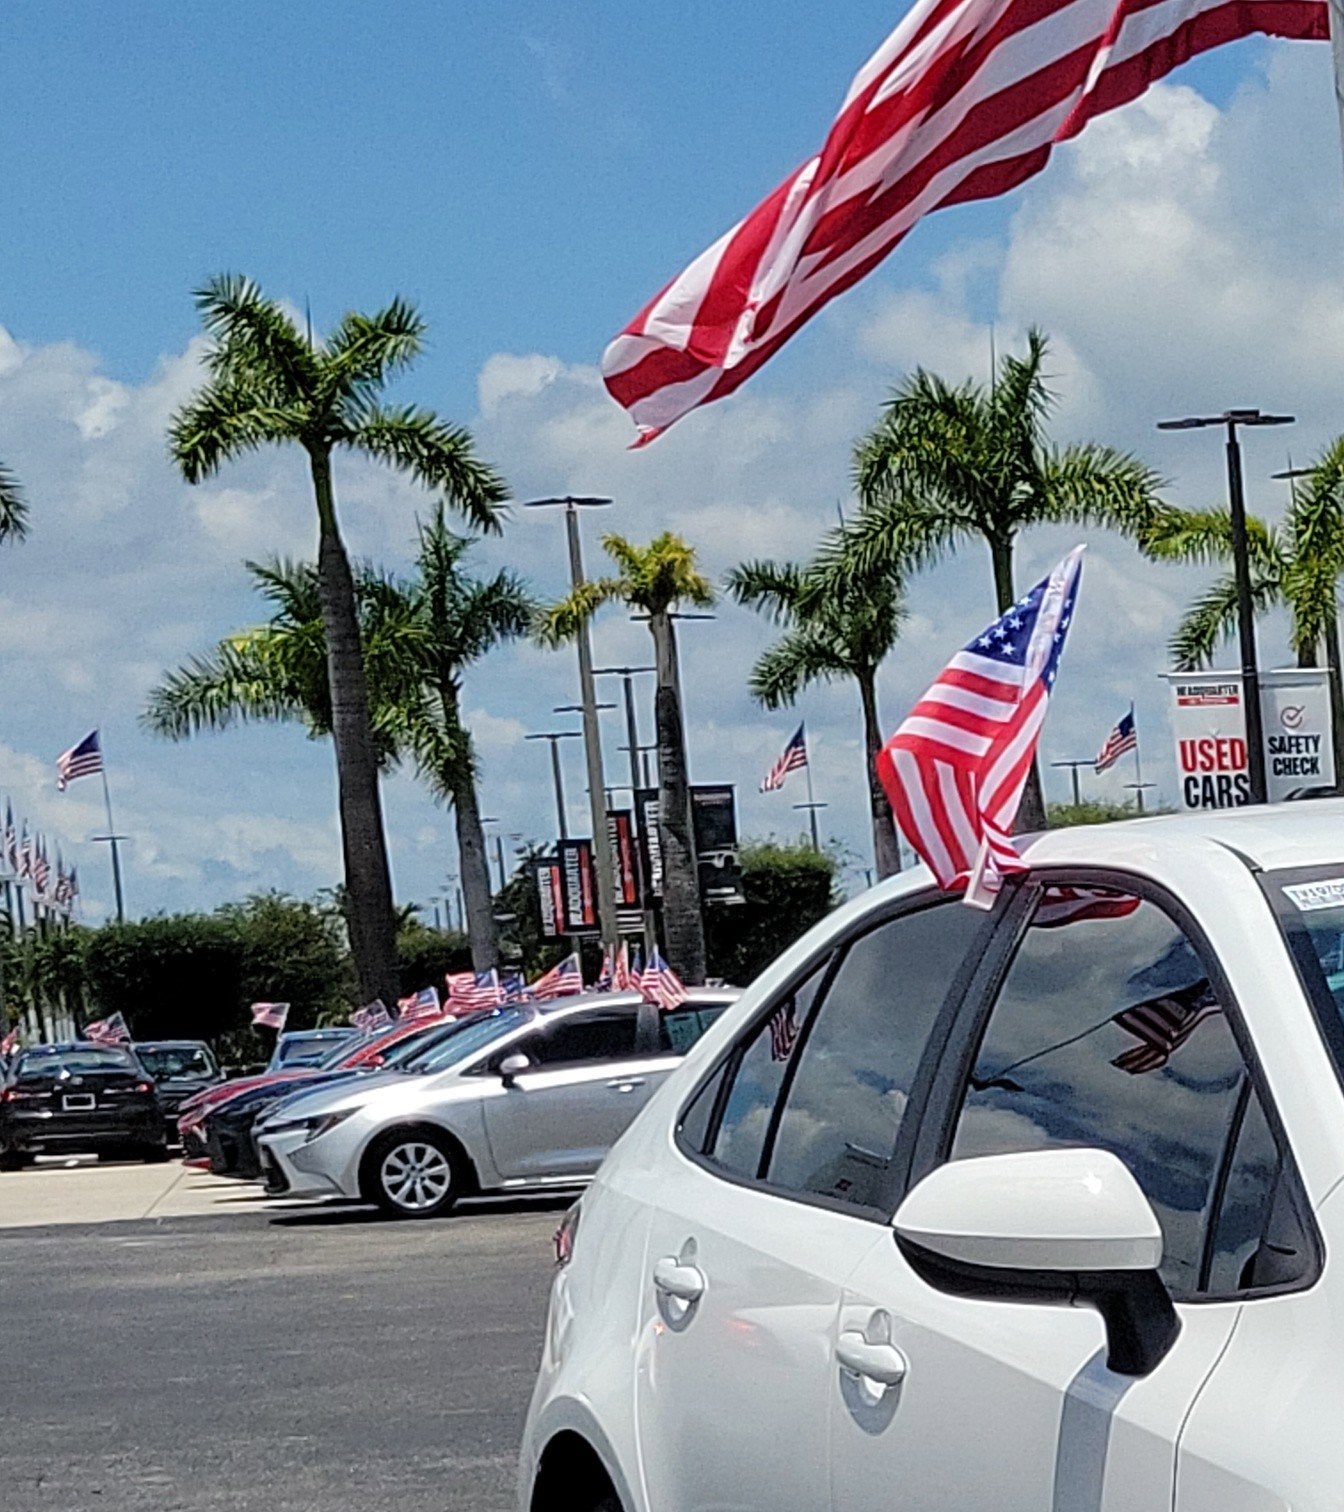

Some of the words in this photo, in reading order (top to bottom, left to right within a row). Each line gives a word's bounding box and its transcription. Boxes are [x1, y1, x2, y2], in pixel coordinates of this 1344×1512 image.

[1179, 738, 1247, 773] USED
[1268, 734, 1321, 755] SAFETY
[1273, 757, 1320, 776] CHECK
[1184, 774, 1250, 809] CARS
